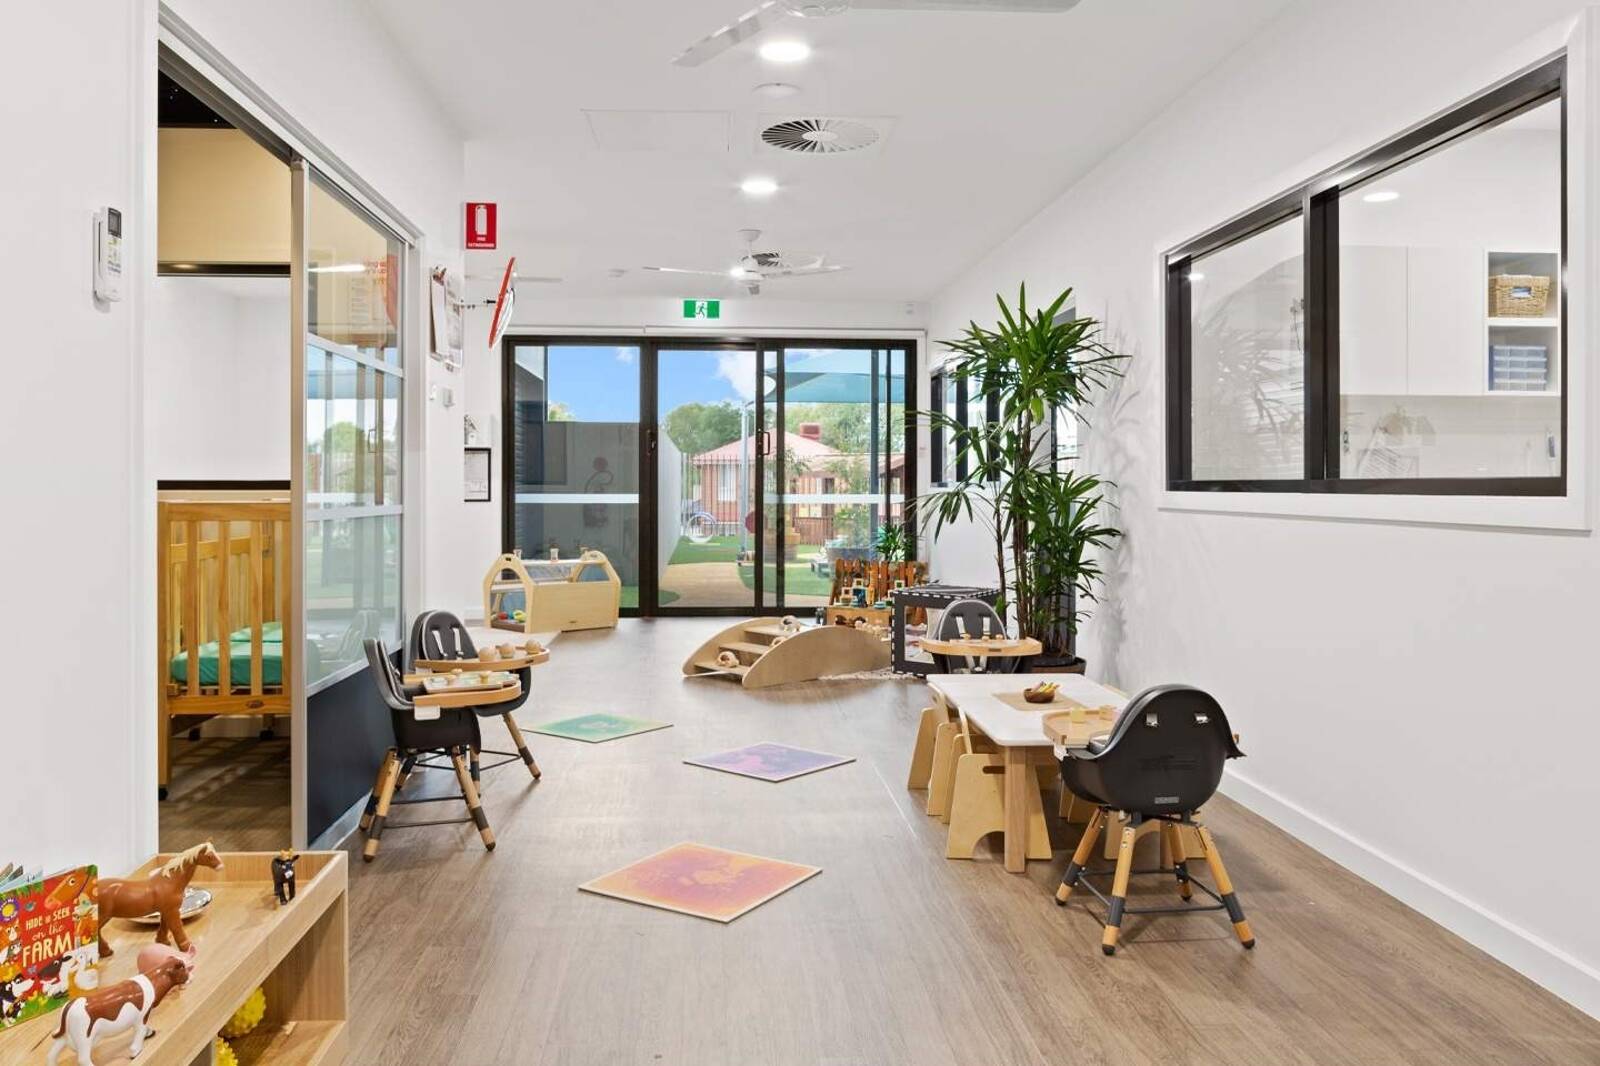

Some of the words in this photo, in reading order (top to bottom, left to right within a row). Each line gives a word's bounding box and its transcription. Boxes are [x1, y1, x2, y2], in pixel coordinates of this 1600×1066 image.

[26, 915, 43, 930] HIDE
[53, 907, 70, 921] SEEK
[49, 921, 64, 936] the
[22, 931, 72, 968] FARM
